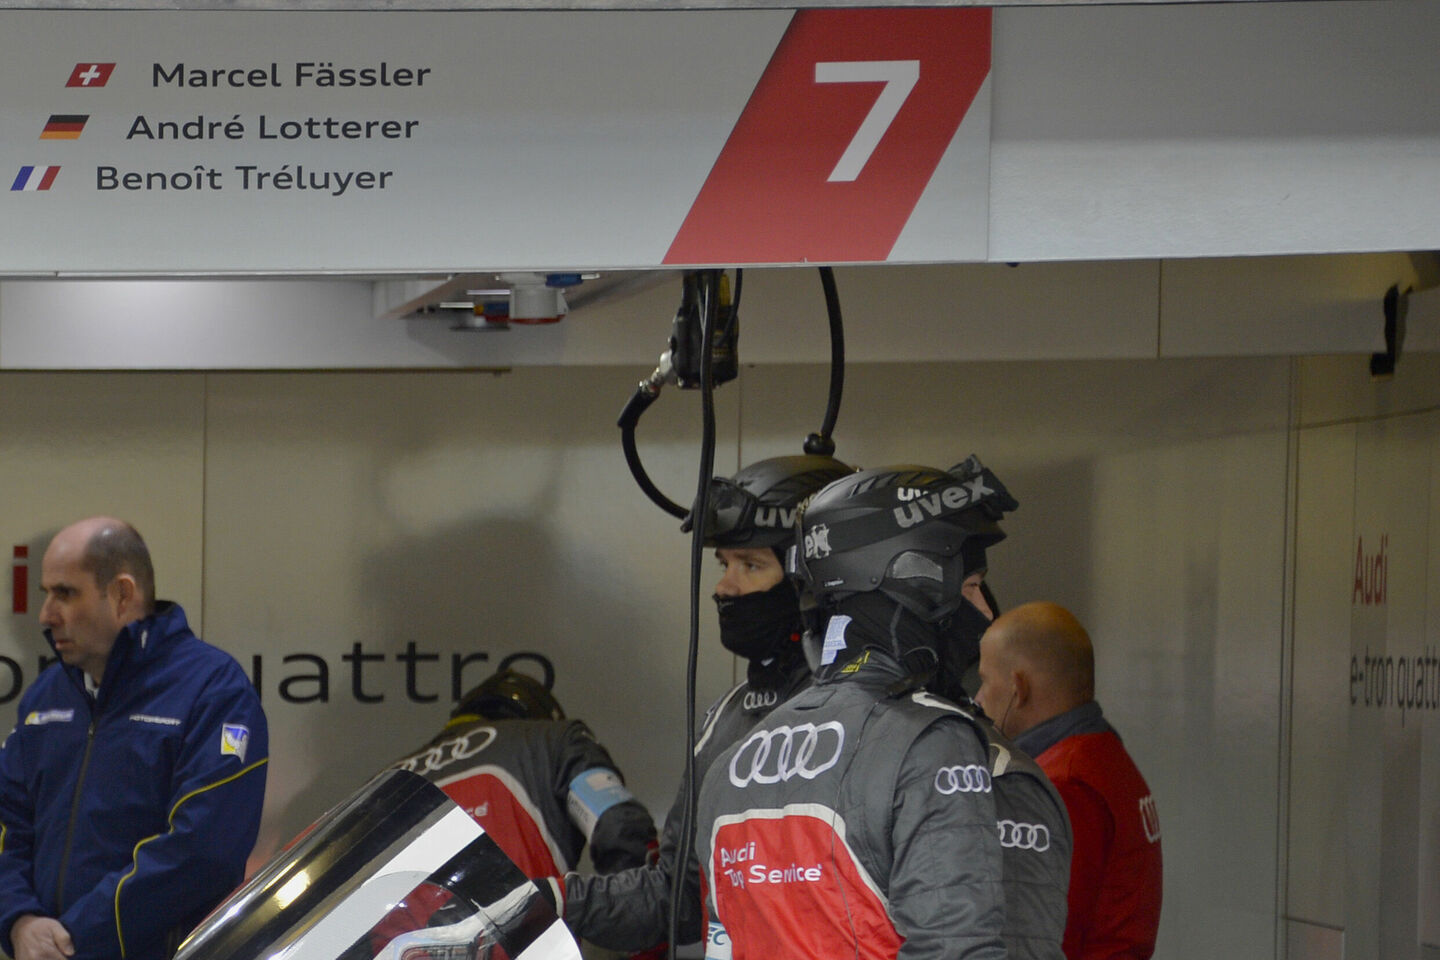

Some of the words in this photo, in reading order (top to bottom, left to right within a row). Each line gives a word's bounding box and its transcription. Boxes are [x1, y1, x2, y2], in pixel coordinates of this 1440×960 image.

[152, 63, 281, 88] Marcel
[295, 63, 431, 88] Fässler
[126, 115, 245, 140] André
[259, 116, 419, 140] Lotterer
[815, 60, 920, 182] 7
[96, 165, 223, 190] Benoît
[235, 165, 393, 196] Tréluyer
[893, 474, 994, 529] uvex
[1353, 534, 1388, 606] Audi
[1350, 645, 1394, 707] e-tron
[720, 841, 756, 868] Audi
